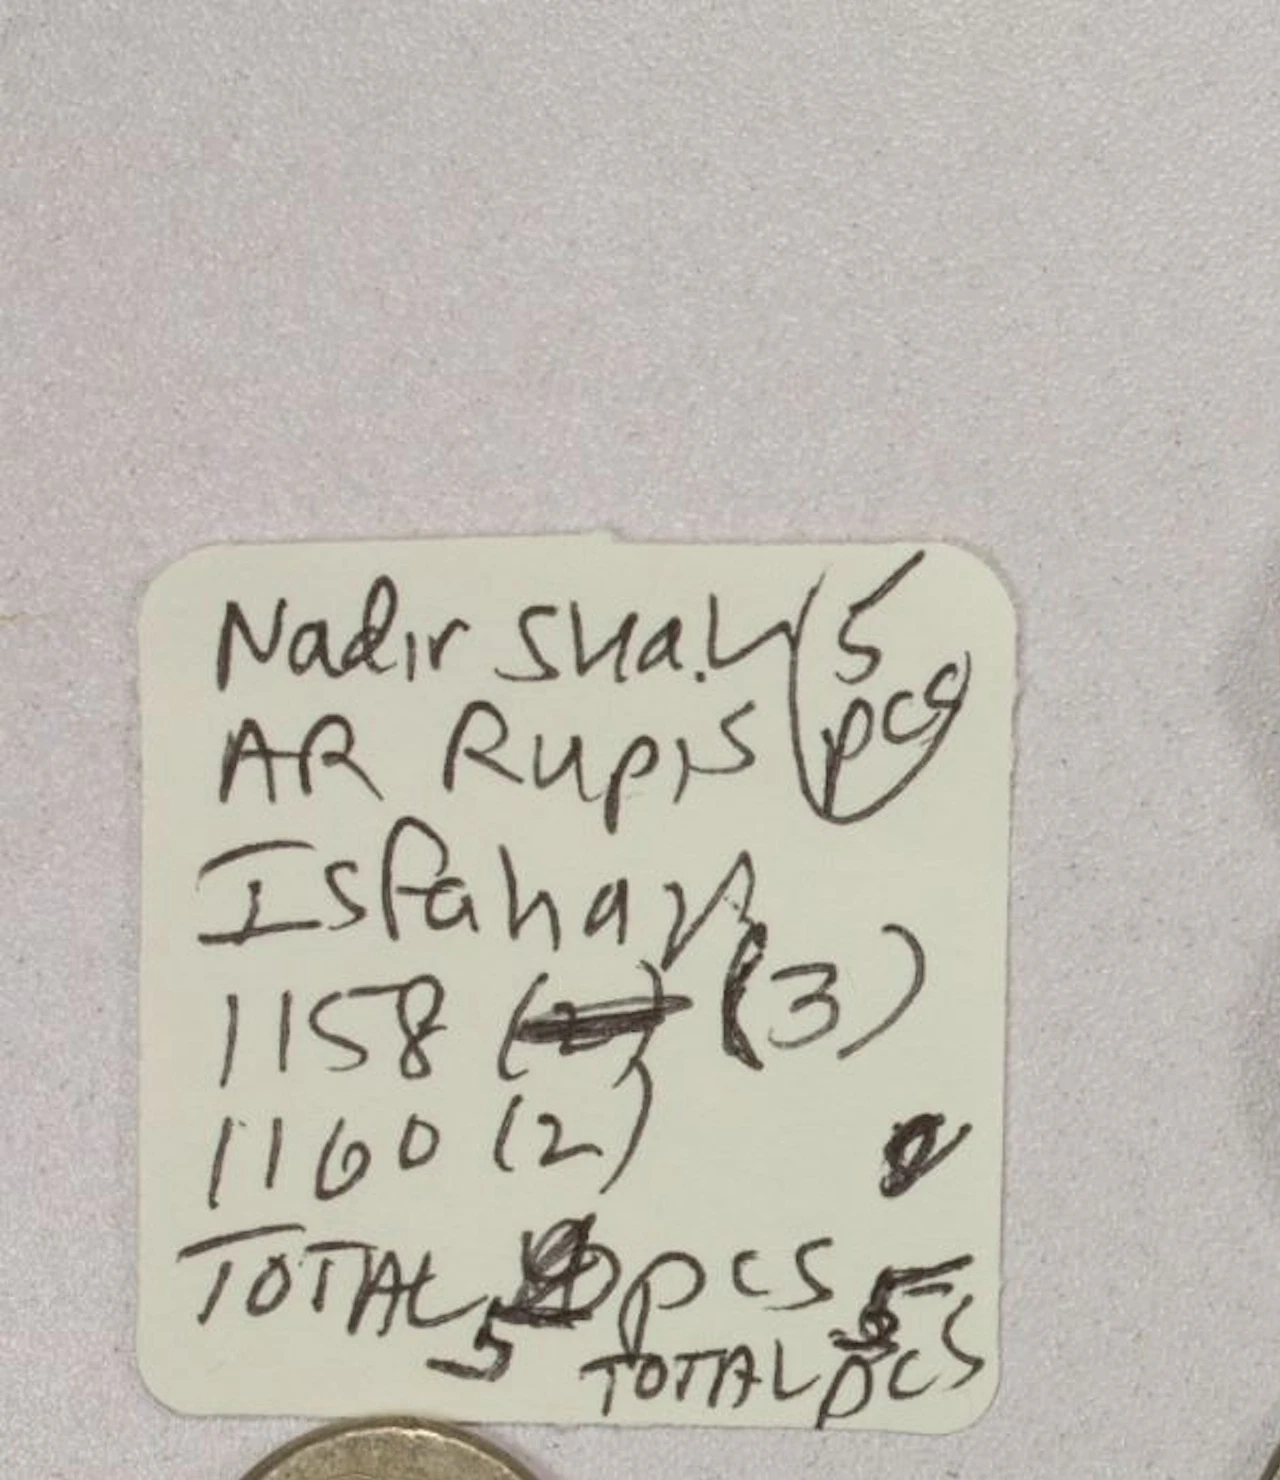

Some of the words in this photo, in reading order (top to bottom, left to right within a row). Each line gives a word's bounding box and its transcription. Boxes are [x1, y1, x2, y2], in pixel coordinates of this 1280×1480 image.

[216, 575, 471, 691] Nadir
[218, 712, 384, 804] AR
[218, 973, 447, 1089] 1158
[721, 922, 927, 1071] (3)
[207, 1112, 440, 1209] 1160
[493, 1056, 654, 1195] (2)
[177, 1222, 490, 1337] TOTAL
[579, 1338, 823, 1417] TOTAL
